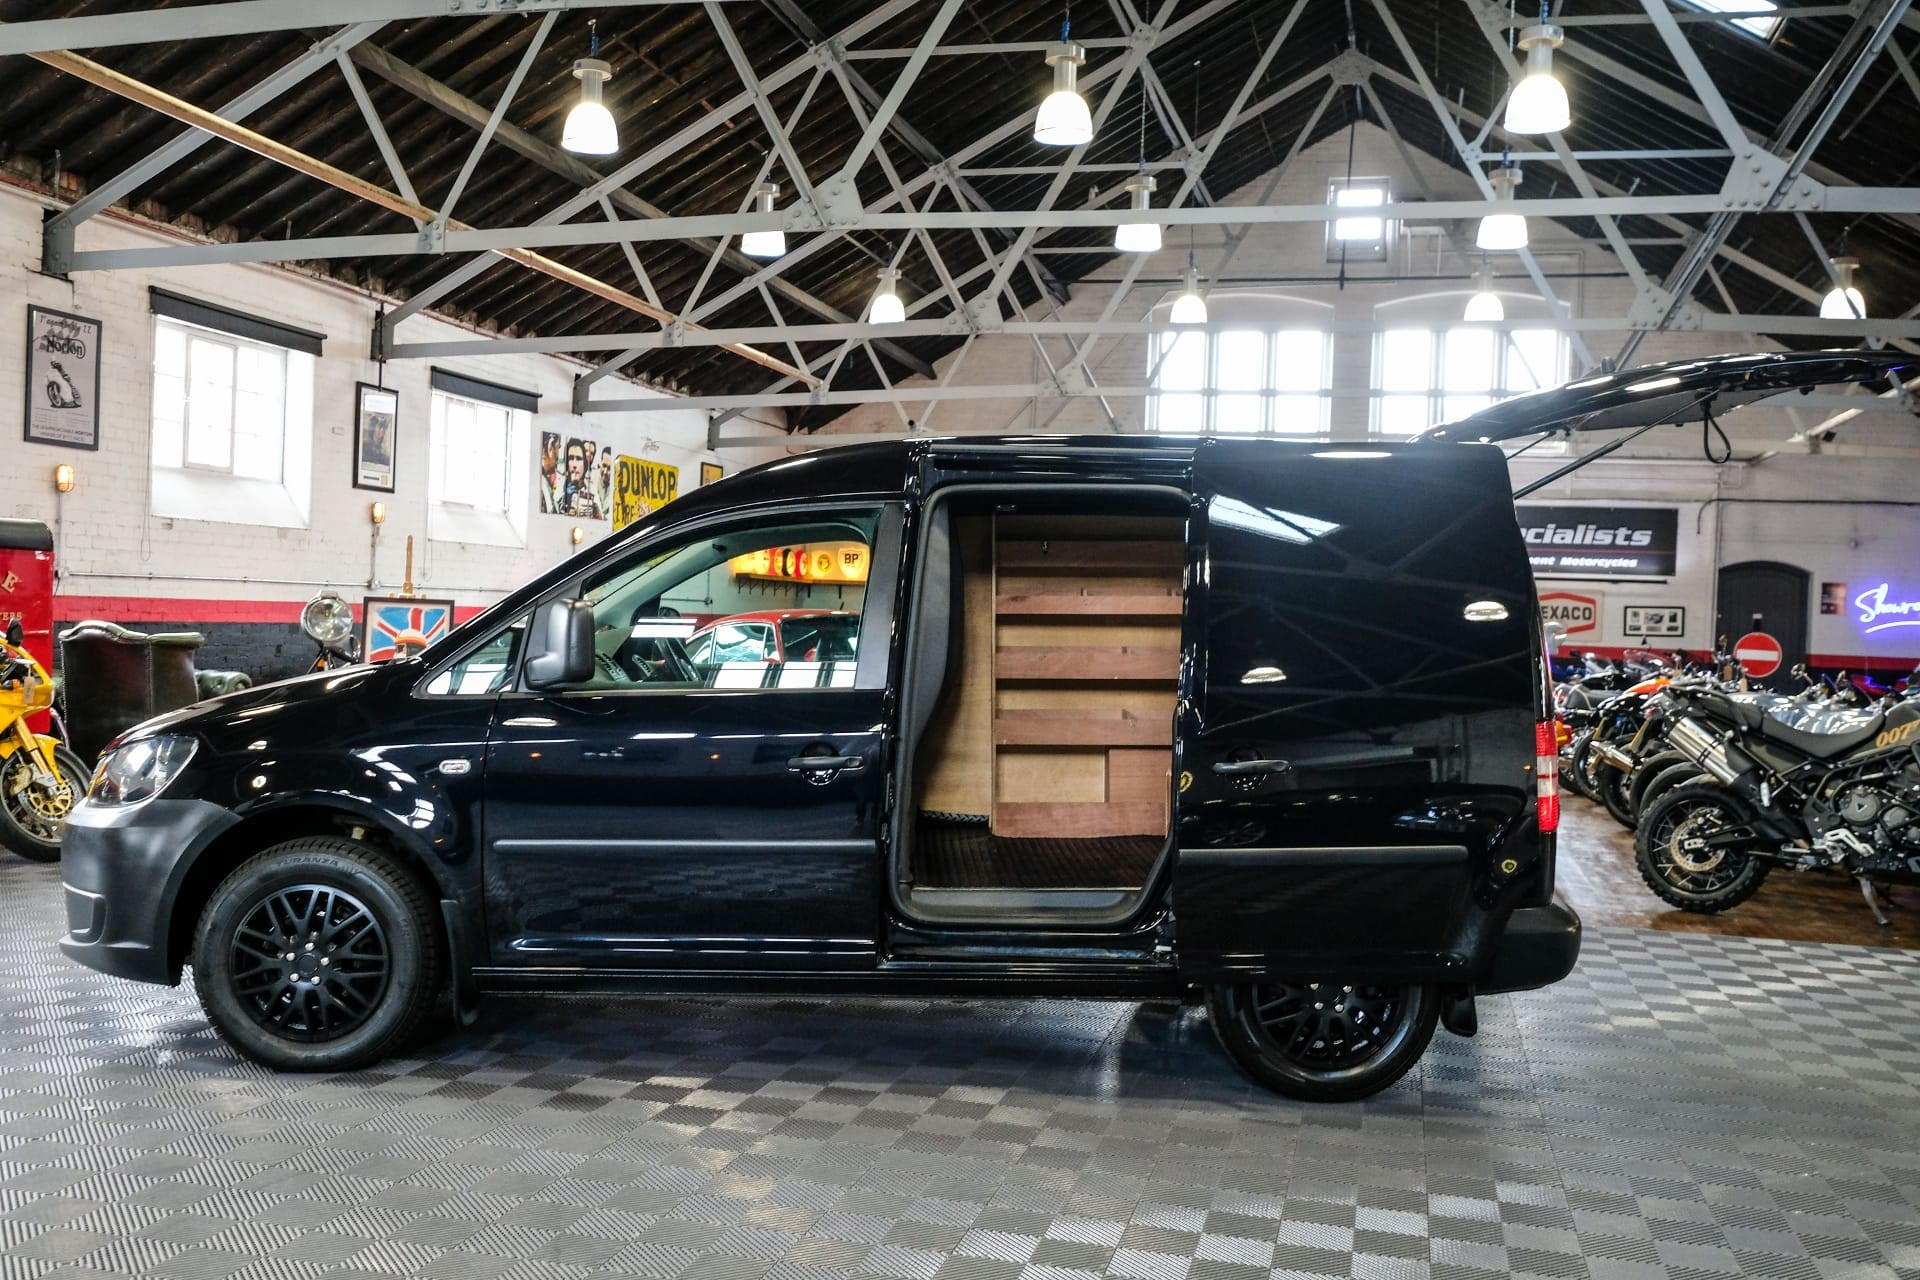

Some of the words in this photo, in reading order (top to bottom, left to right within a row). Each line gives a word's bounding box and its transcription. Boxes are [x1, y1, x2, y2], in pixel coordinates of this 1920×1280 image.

[46, 335, 86, 359] Norton
[618, 459, 677, 502] DUNLOP
[844, 553, 859, 565] BP
[1559, 557, 1639, 569] Motorcycles
[1875, 721, 1914, 749] 007
